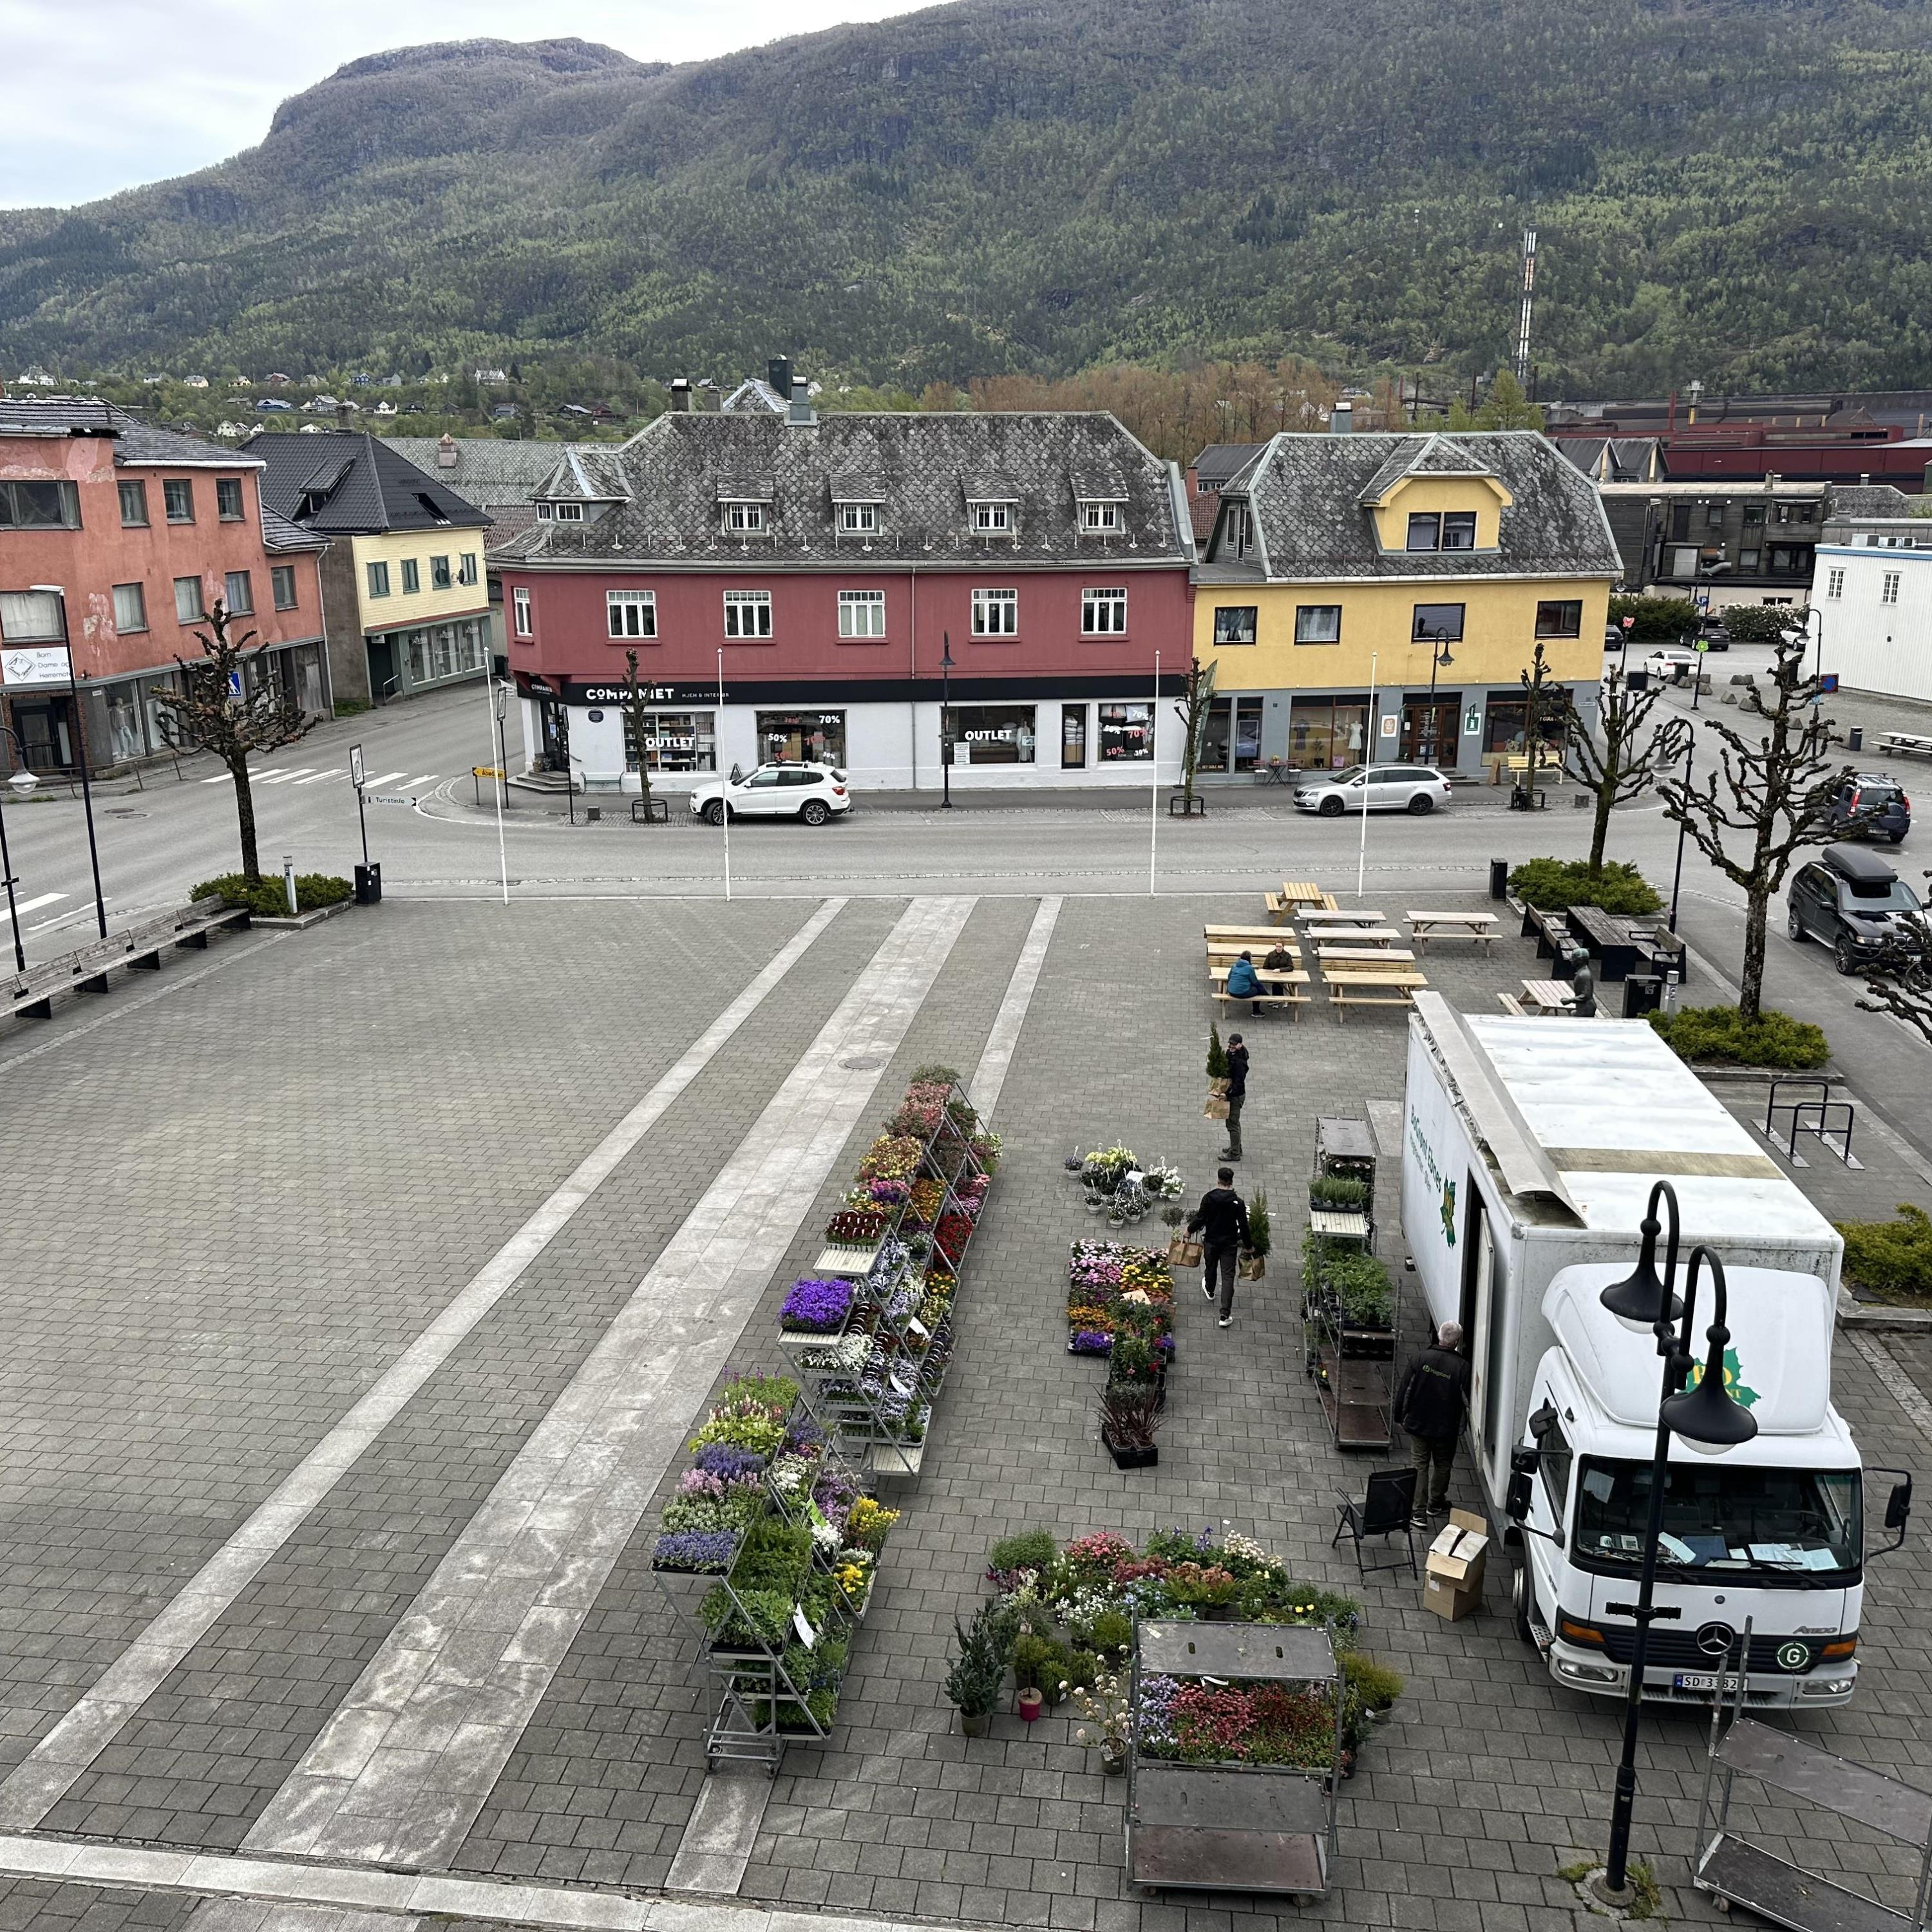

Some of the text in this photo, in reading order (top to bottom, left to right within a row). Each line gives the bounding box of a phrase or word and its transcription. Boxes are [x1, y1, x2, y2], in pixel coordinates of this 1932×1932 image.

[819, 715, 840, 724] 70%
[1133, 710, 1149, 720] 70%
[768, 734, 787, 743] 50%
[965, 730, 1012, 740] OUTLET
[645, 737, 695, 748] OUTLET
[1106, 746, 1124, 756] 50%
[1786, 1648, 1801, 1663] G
[1685, 1677, 1700, 1686] SD
